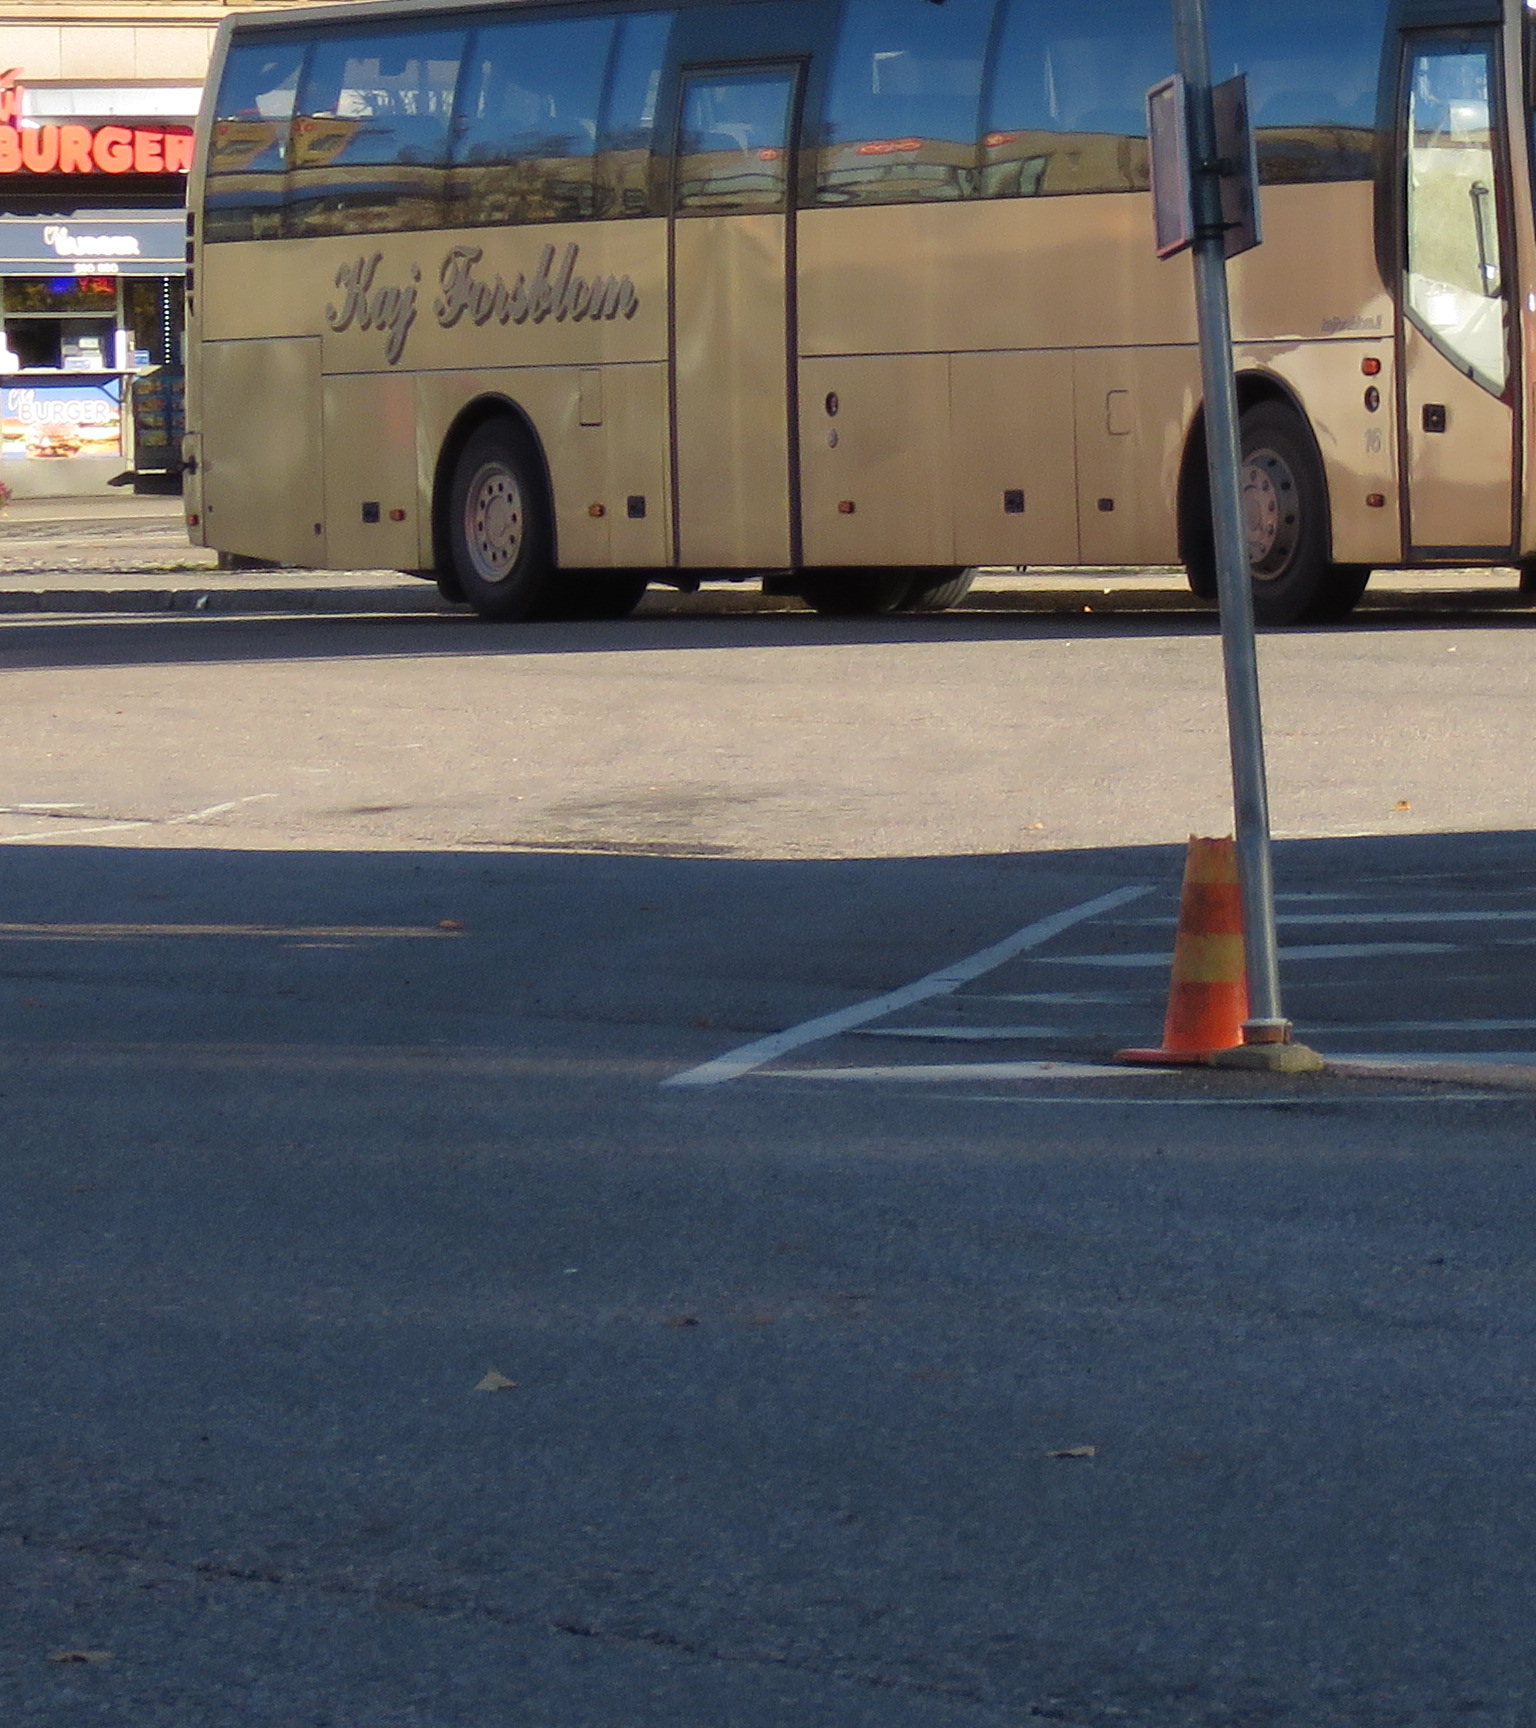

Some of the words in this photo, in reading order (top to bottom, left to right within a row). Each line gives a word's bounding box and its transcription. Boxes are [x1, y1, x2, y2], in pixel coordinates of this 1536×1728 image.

[326, 251, 421, 364] Kaj
[434, 243, 639, 328] Forsblom
[19, 400, 112, 424] BURGER
